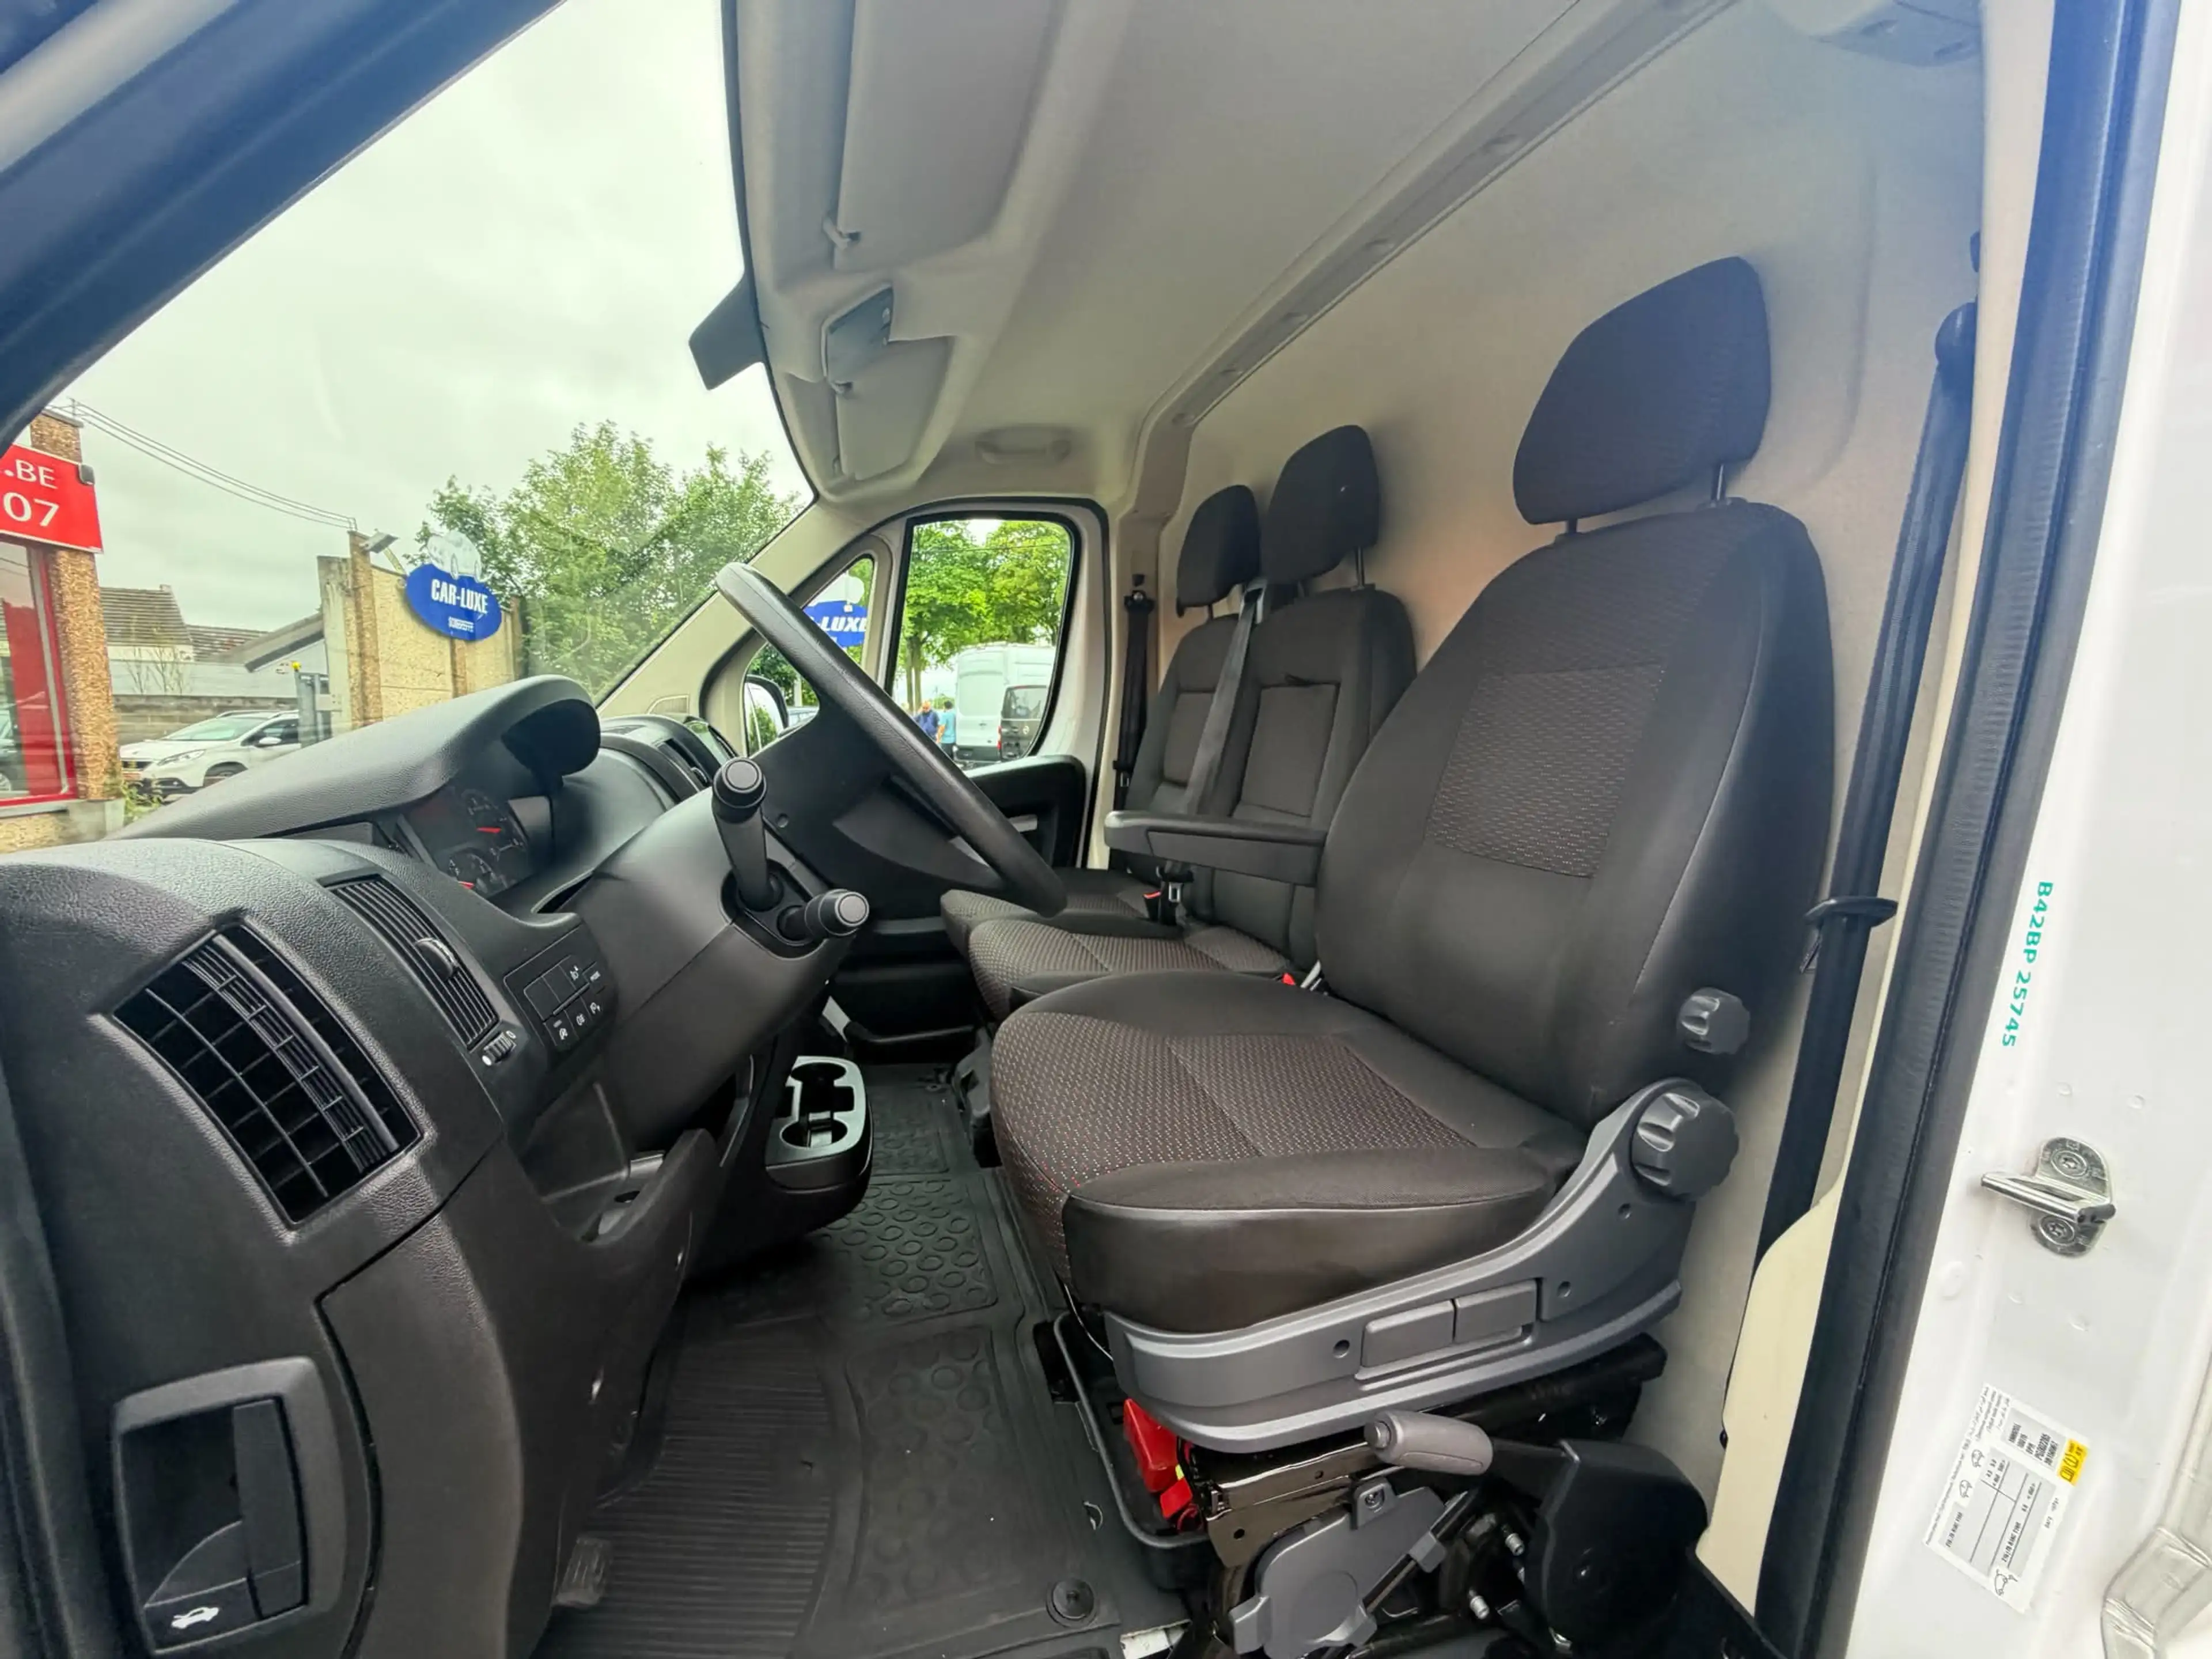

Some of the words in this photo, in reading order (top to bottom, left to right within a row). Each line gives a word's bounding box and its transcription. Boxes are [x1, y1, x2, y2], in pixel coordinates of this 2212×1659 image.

[3, 491, 60, 527] 07
[431, 578, 488, 614] CAR-LUXE
[2024, 881, 2054, 964] B42BP
[2002, 970, 2031, 1047] 25745
